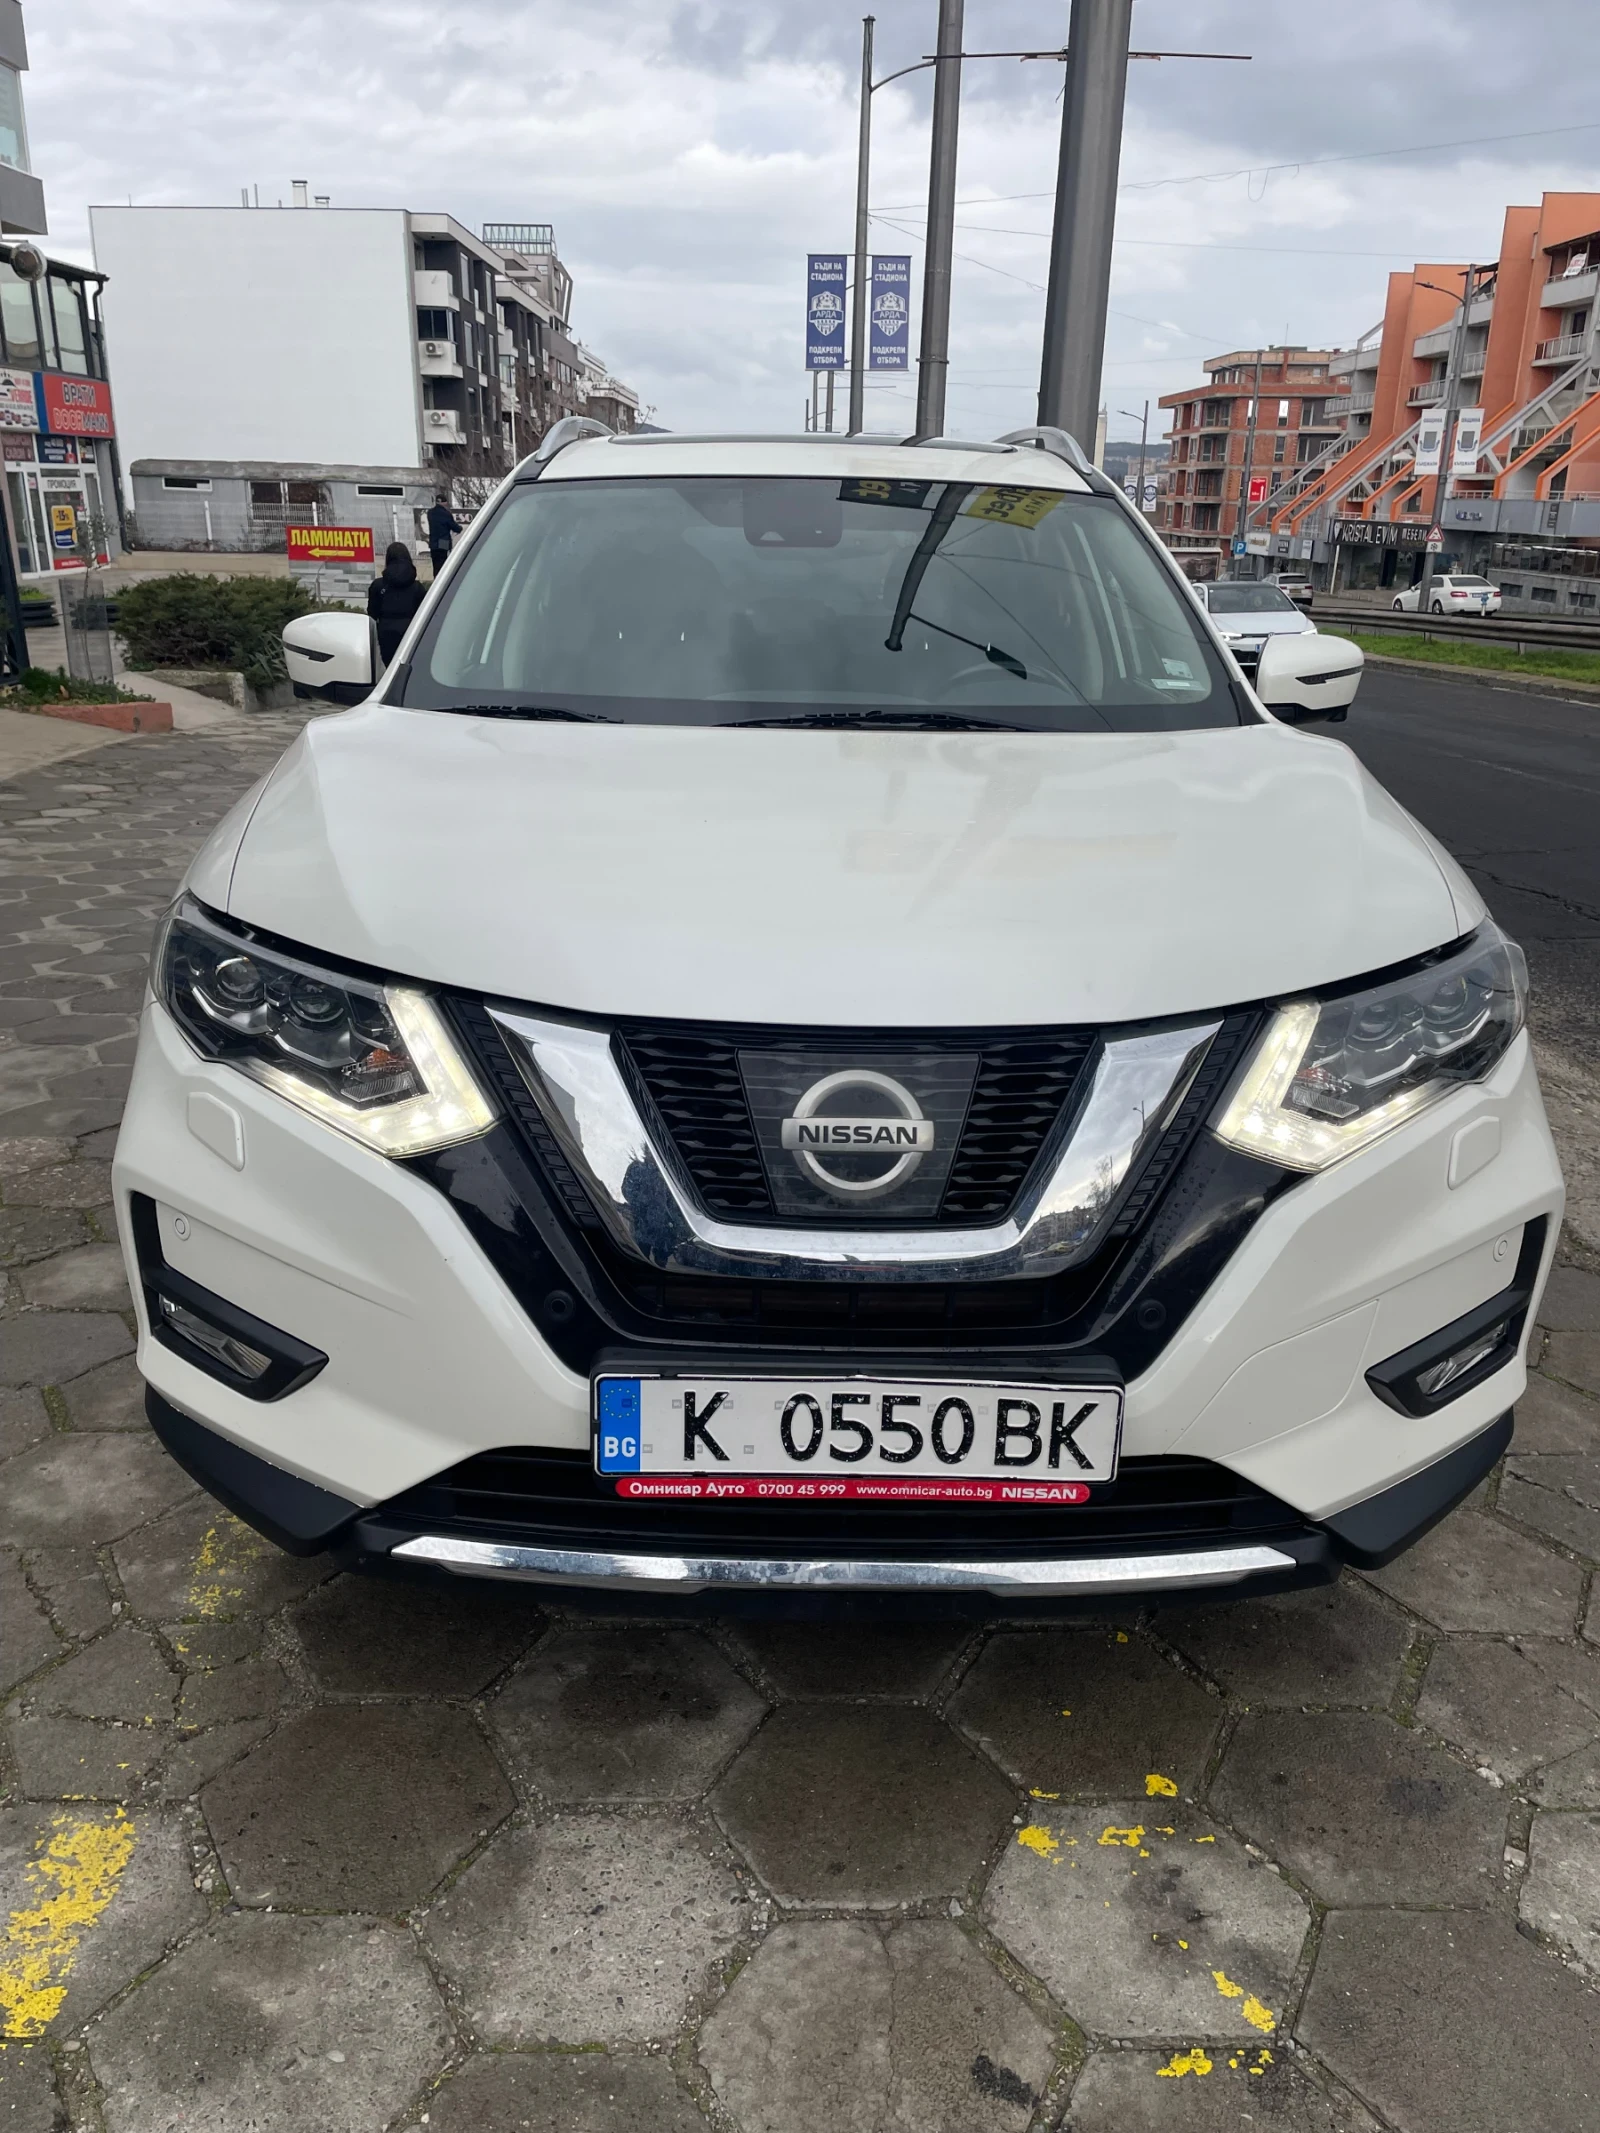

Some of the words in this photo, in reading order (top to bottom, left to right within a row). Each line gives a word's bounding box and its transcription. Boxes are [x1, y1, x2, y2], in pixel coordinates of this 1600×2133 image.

[814, 262, 832, 271] БЪДИ
[833, 263, 842, 271] НА
[878, 263, 896, 271] БЪДИ
[897, 263, 906, 271] НА
[810, 272, 844, 282] СТАДИОНА
[874, 273, 908, 282] СТАДИОНА
[815, 310, 837, 319] АРДА
[879, 310, 900, 319] АРДА
[808, 346, 843, 354] ПОДКРЕПИ
[872, 346, 906, 354] ПОДКРЕПИ
[813, 356, 838, 364] ОТБОРА
[876, 356, 901, 364] ОТБОРА
[62, 382, 96, 408] ВРАТИ
[53, 408, 109, 433] DOORMANN
[47, 479, 76, 489] ПРОМОЦИЯ
[452, 513, 474, 523] ESO
[290, 529, 371, 548] ЛАМИНАТИ
[1236, 543, 1244, 553] P
[798, 1124, 918, 1145] NISSAN
[683, 1391, 731, 1461] K
[780, 1392, 975, 1465] 0550
[994, 1398, 1099, 1470] BK
[603, 1435, 637, 1458] BG
[629, 1481, 701, 1497] Омникар
[706, 1481, 745, 1497] Ауто
[758, 1484, 794, 1495] 0700
[797, 1484, 815, 1495] 45
[819, 1484, 846, 1496] 999
[856, 1486, 993, 1499] www.omnicar-auto.bg
[1002, 1487, 1078, 1500] NISSAN
